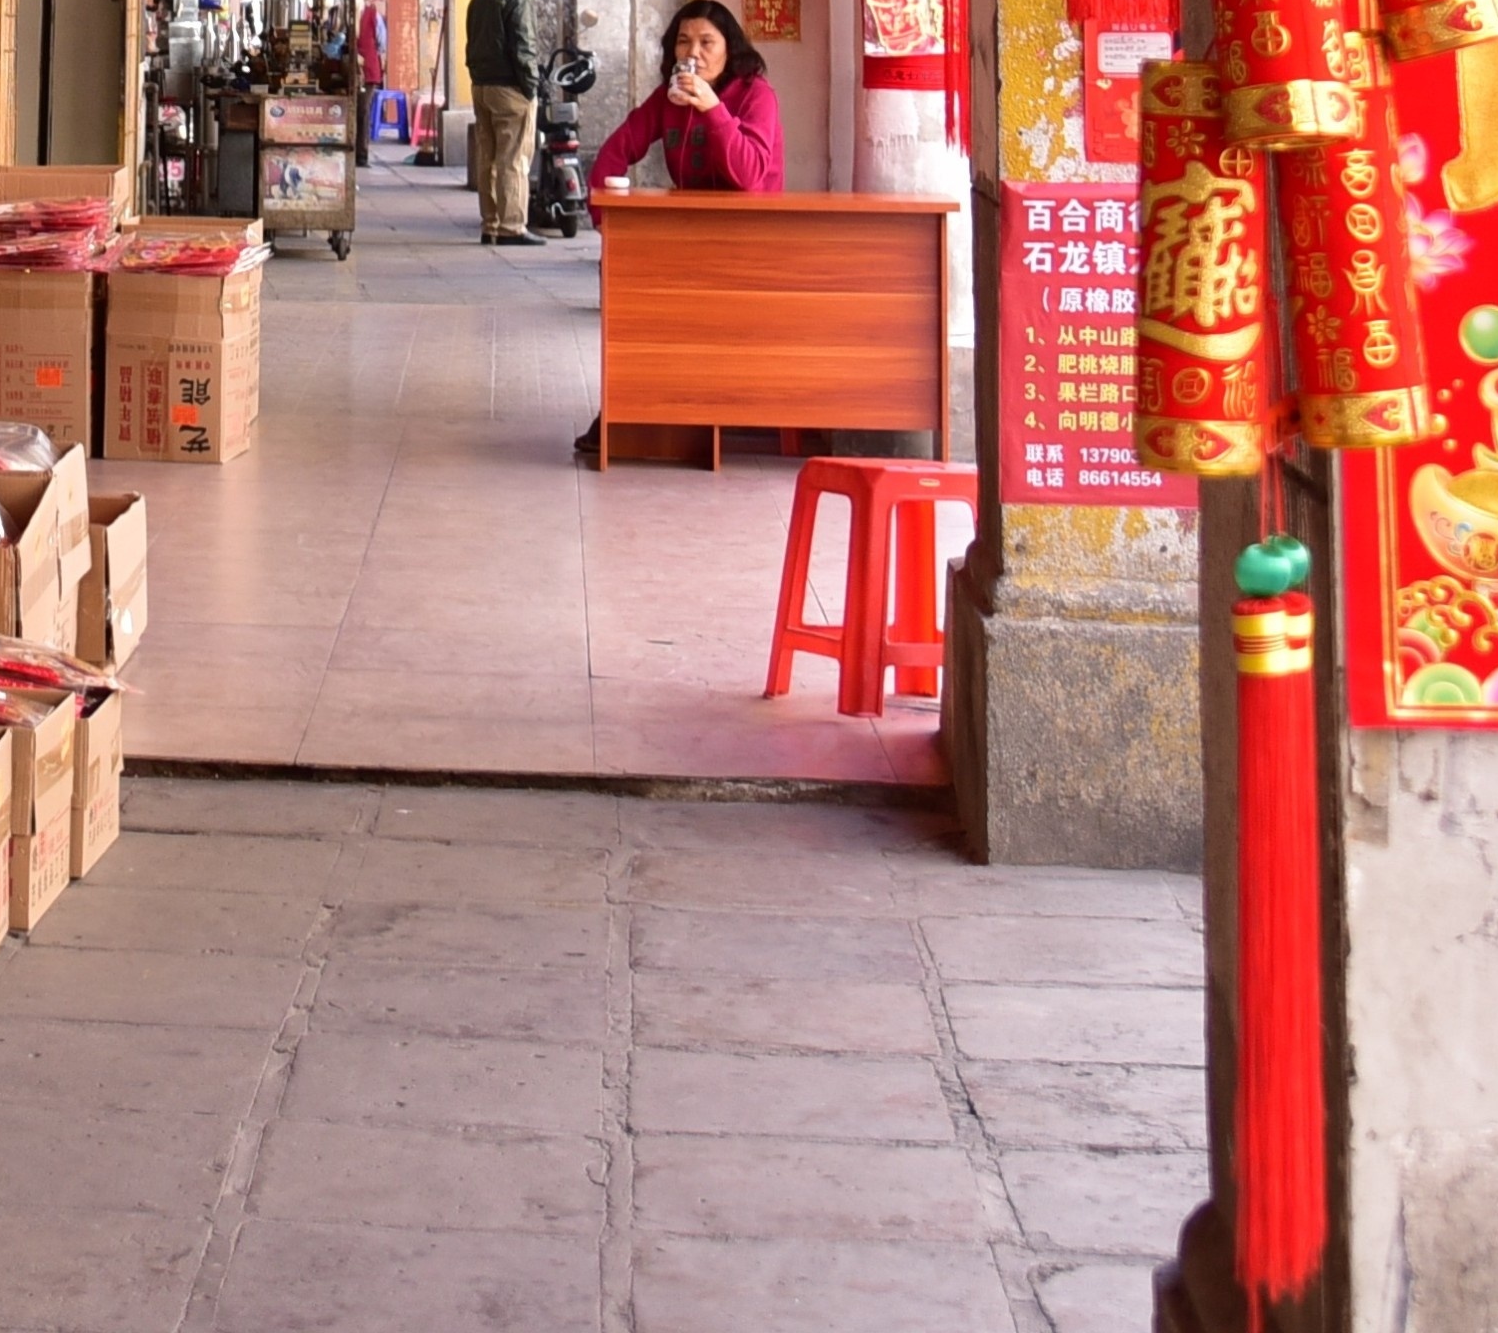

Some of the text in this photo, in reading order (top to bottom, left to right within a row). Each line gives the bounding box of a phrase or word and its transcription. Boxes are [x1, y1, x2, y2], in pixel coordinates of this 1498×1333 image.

[1023, 241, 1139, 275] 石龙镇
[1025, 444, 1064, 464] 联系
[1026, 468, 1162, 489] 电话 86614554
